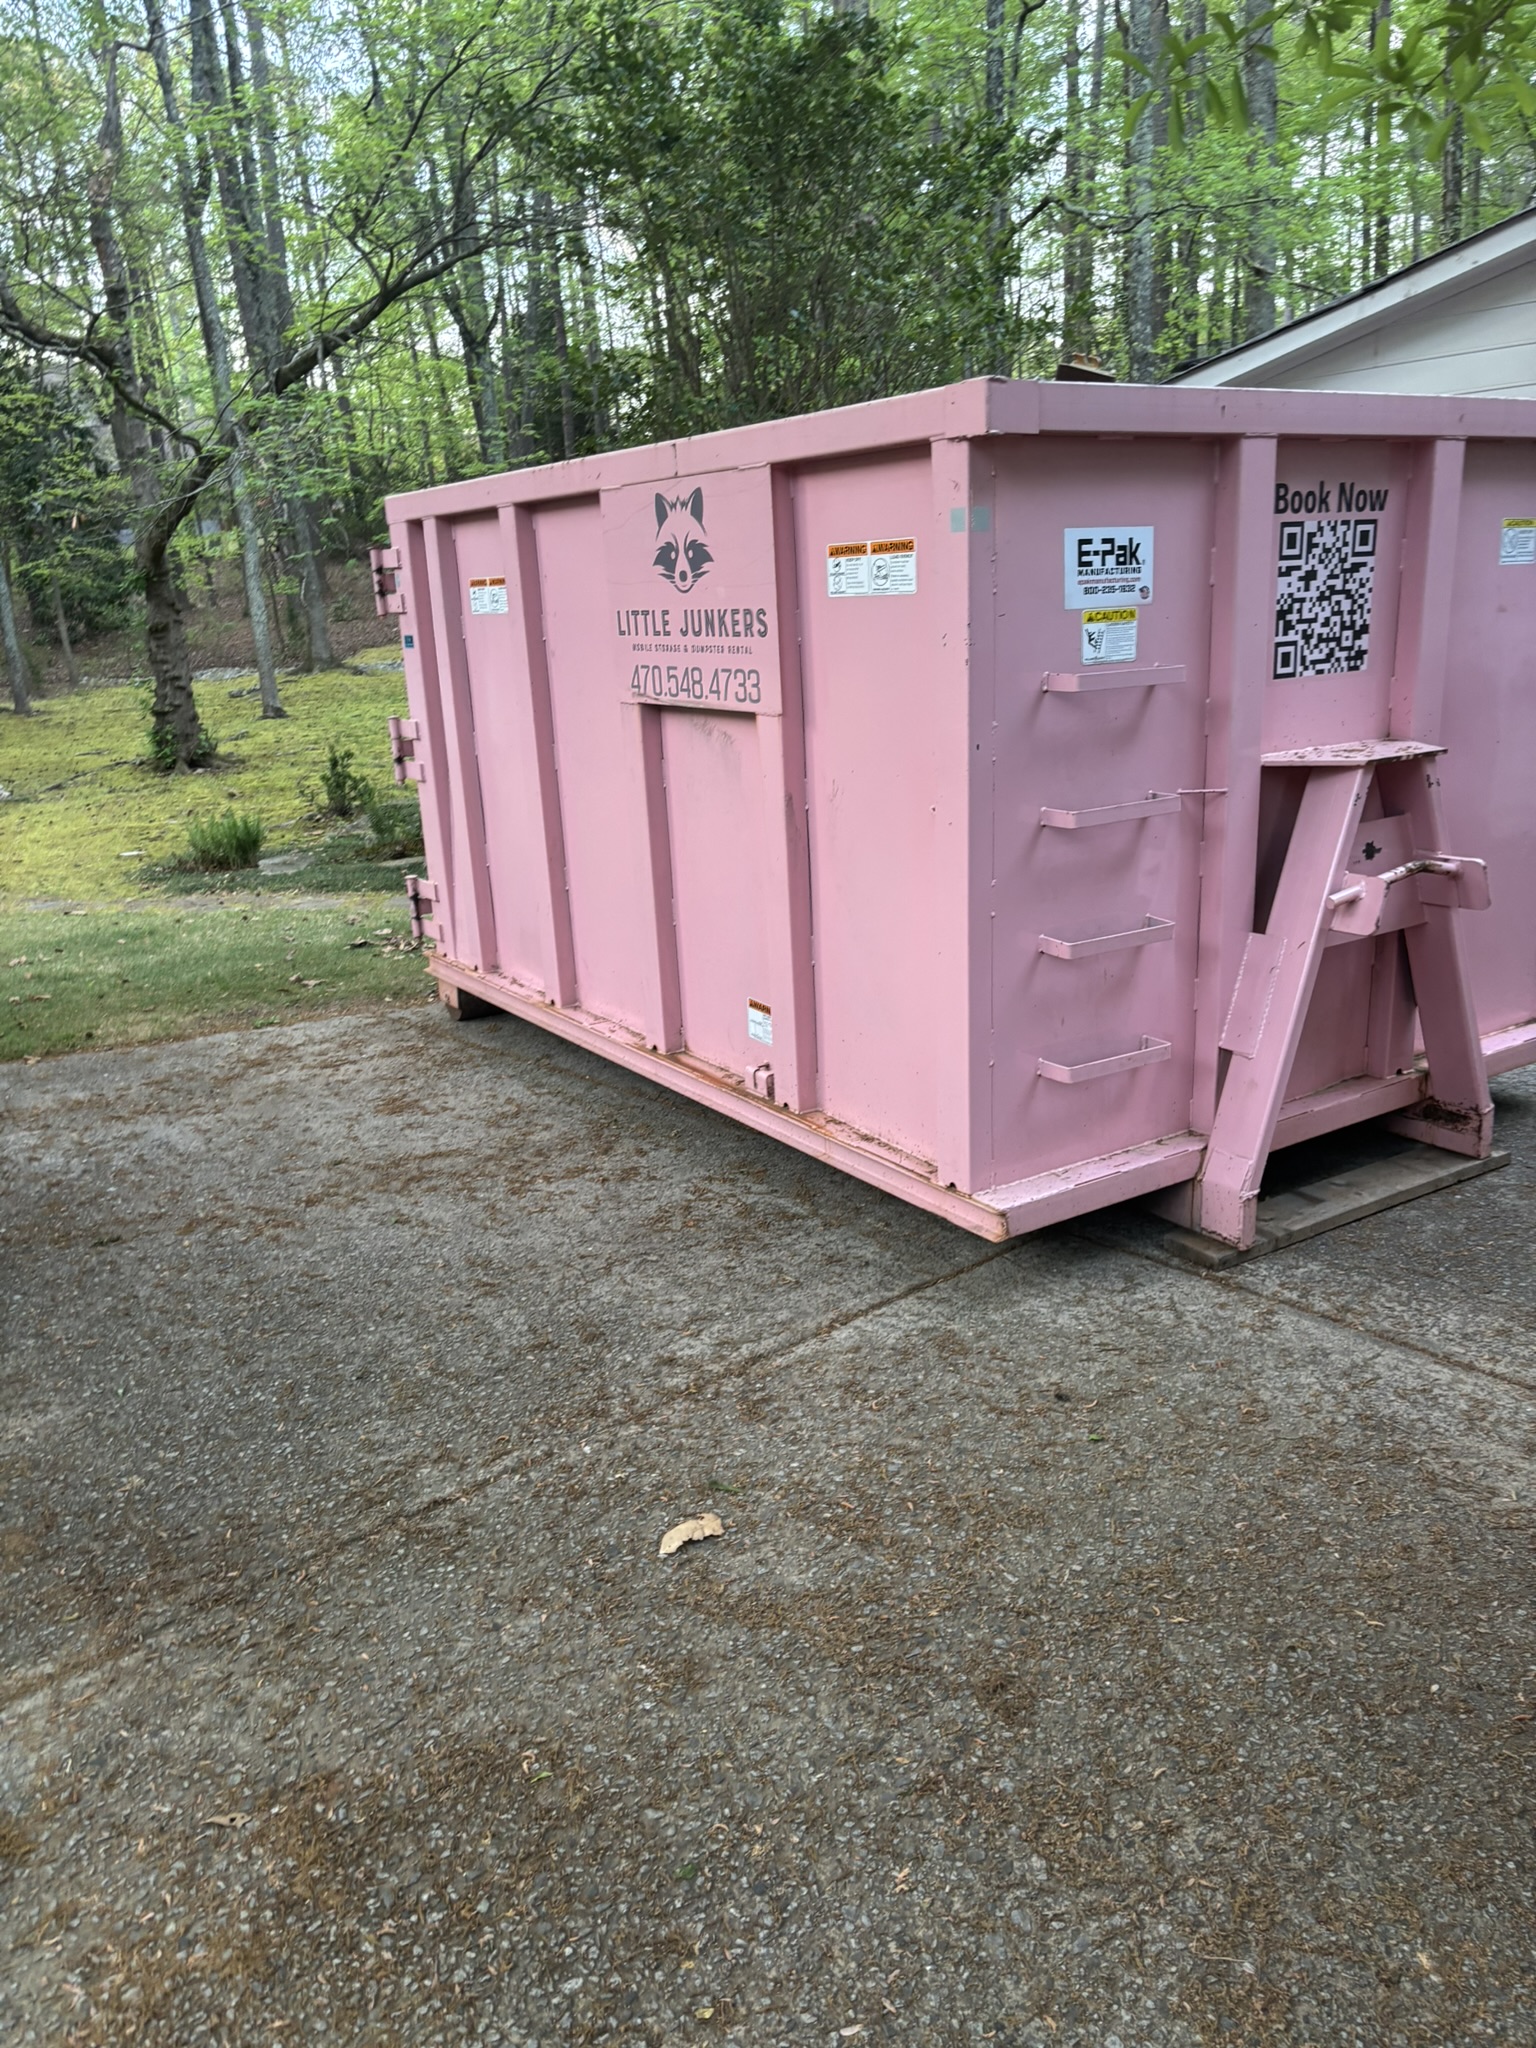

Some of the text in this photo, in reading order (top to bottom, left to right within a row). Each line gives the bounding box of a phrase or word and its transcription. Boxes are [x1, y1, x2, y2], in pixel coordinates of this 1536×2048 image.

[1274, 481, 1389, 514] Book Now
[836, 545, 867, 555] WARNING
[879, 541, 914, 554] WARNING
[1077, 537, 1142, 568] E-Pak
[1077, 566, 1142, 577] MANUFACTURING
[616, 607, 769, 638] LITTLE JUNKERS
[691, 644, 725, 654] DUMPSTER
[631, 664, 762, 704] 470.548.4733
